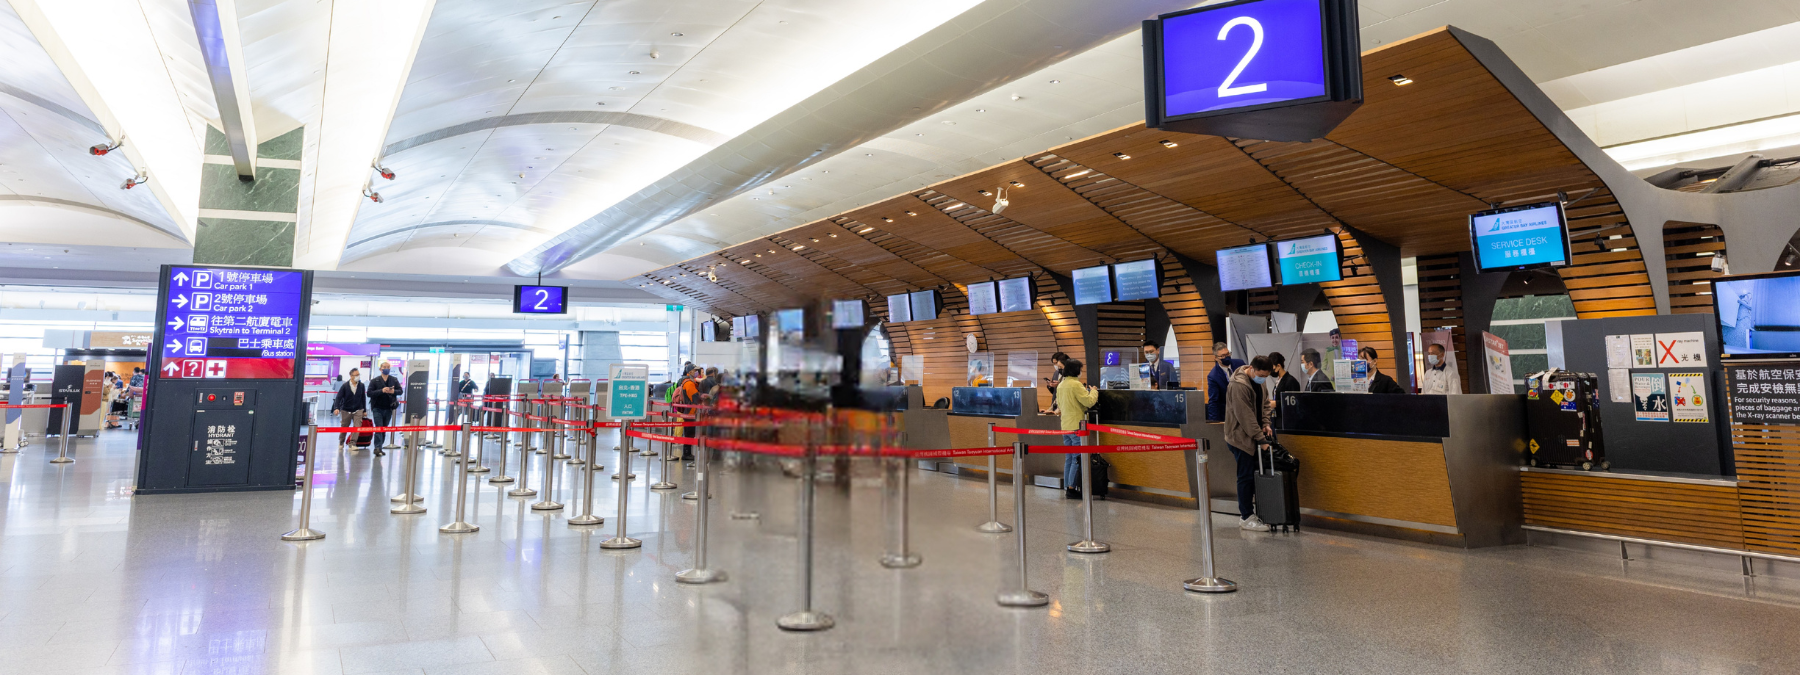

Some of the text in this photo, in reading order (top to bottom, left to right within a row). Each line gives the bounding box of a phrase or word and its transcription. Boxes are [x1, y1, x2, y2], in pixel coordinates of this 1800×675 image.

[1217, 16, 1267, 98] 2
[1491, 236, 1548, 250] SERVICE DESK
[1294, 261, 1322, 270] CHECK-IN
[218, 271, 273, 283] 1號停車場
[229, 283, 247, 291] park
[214, 293, 268, 305] 2號停車場
[534, 289, 549, 310] 2
[229, 305, 246, 313] park
[211, 315, 293, 327] 往第二航廈電車
[209, 326, 240, 335] Skytrain
[251, 327, 284, 335] Terminal
[238, 338, 295, 349] 巴士乘車處
[1658, 339, 1680, 364] X
[1736, 382, 1800, 394] 完成安檢無
[1013, 390, 1020, 398] 13
[1174, 393, 1184, 403] 15
[1284, 395, 1296, 406] 16
[1764, 404, 1792, 412] baggage
[1748, 412, 1764, 420] X-ray
